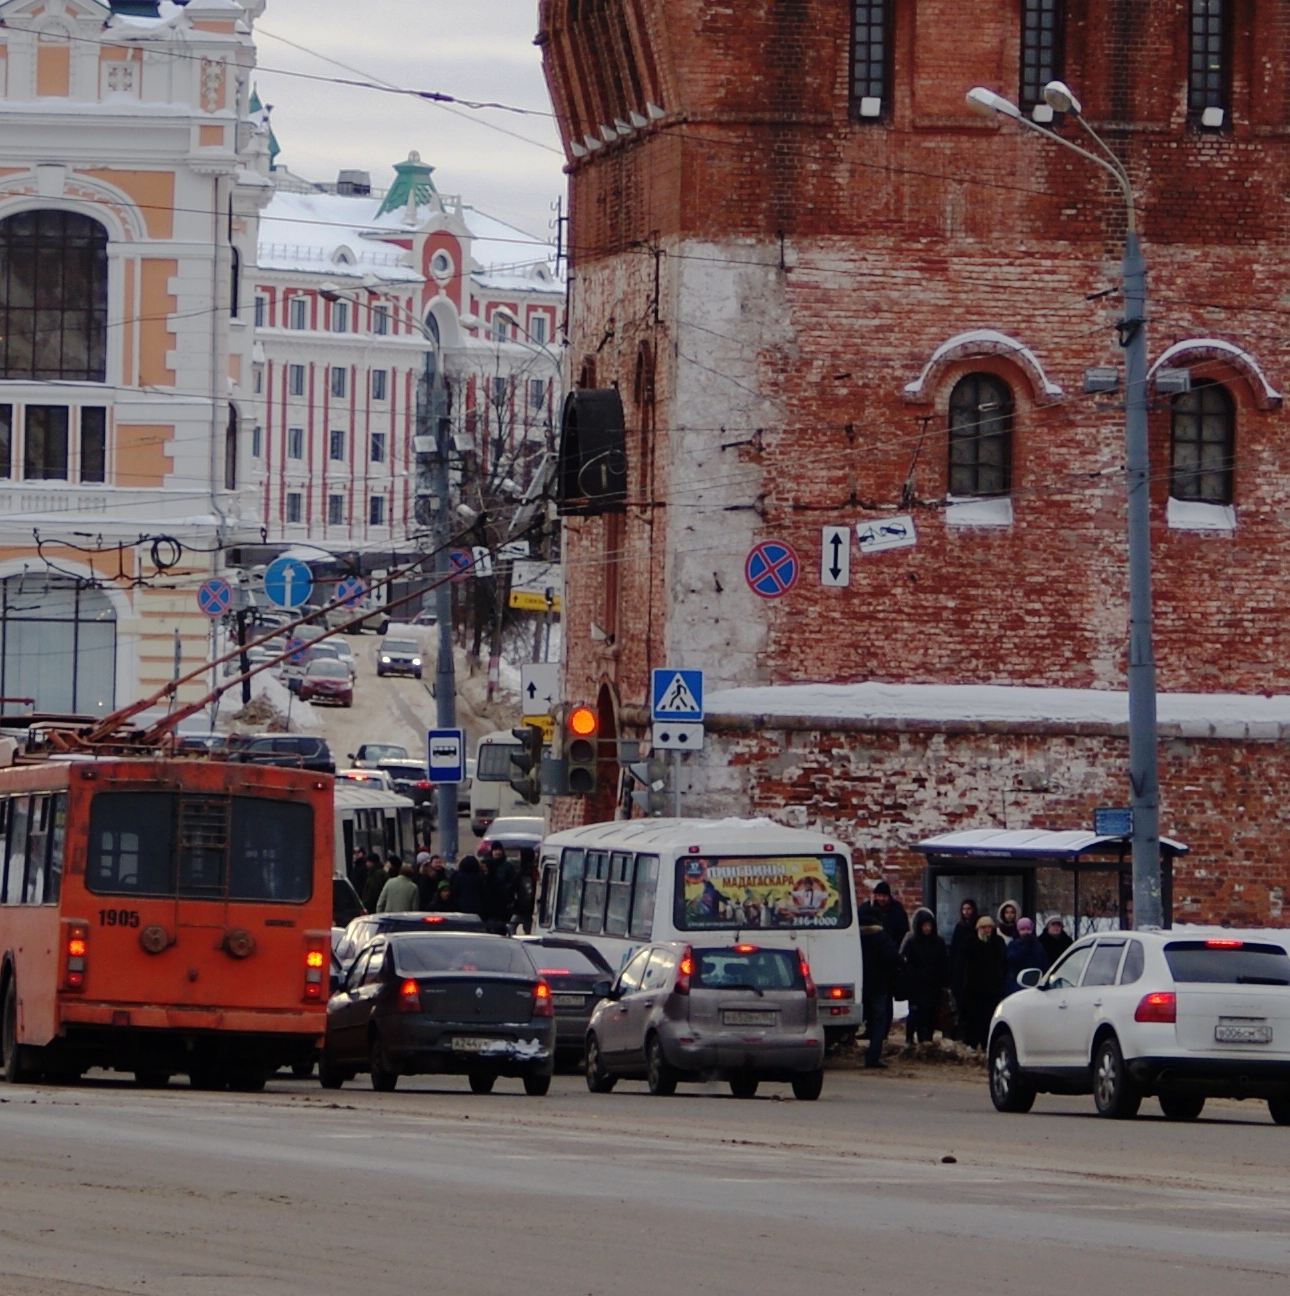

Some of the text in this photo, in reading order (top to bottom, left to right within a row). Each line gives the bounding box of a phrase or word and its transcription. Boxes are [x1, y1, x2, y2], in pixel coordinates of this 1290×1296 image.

[706, 863, 786, 878] ПИНГВИНЫ
[722, 875, 795, 889] МАДАГАСКАРА
[98, 909, 140, 928] 1905
